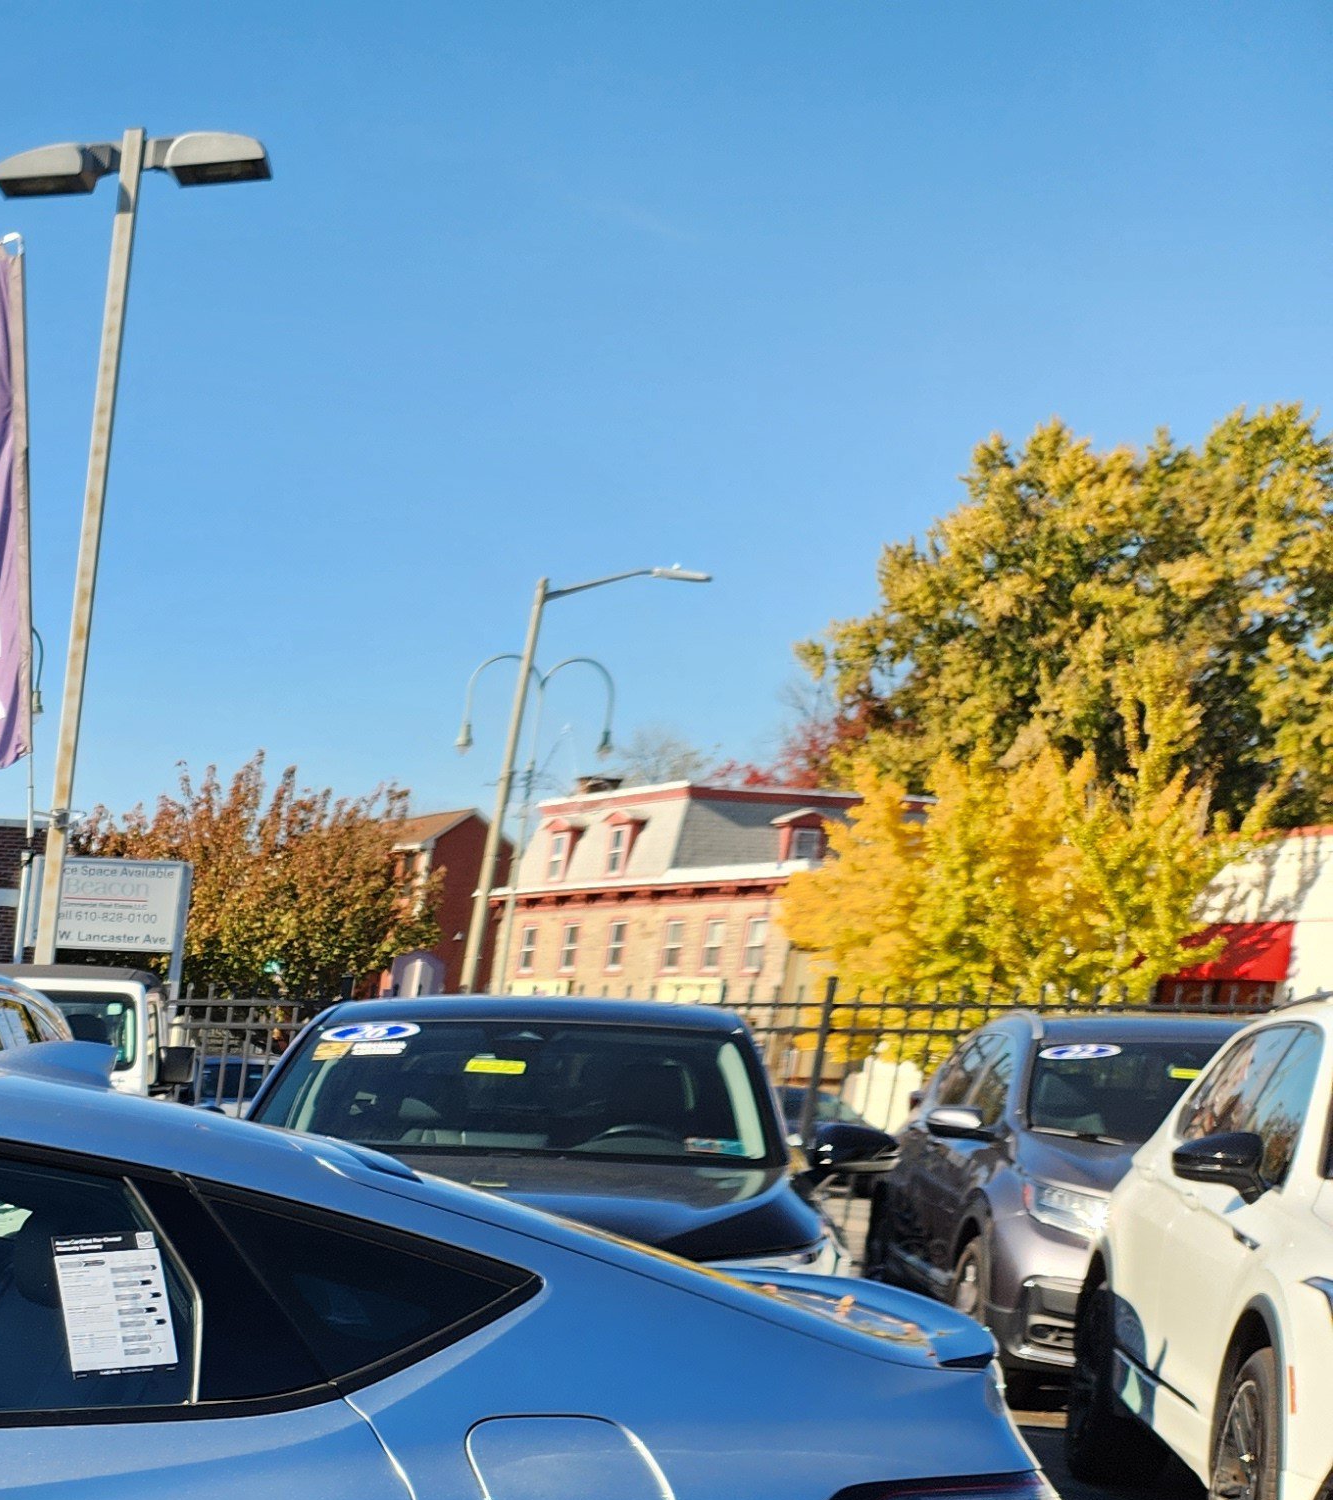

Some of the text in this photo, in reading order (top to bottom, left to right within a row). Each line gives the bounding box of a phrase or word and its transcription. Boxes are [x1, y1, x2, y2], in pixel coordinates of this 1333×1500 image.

[80, 865, 118, 878] Space
[119, 866, 175, 880] Available
[64, 877, 150, 897] Beacon
[134, 903, 148, 911] LLC
[74, 910, 158, 924] 610-828-0100
[77, 931, 140, 944] Lancaster
[142, 934, 171, 946] Ave.
